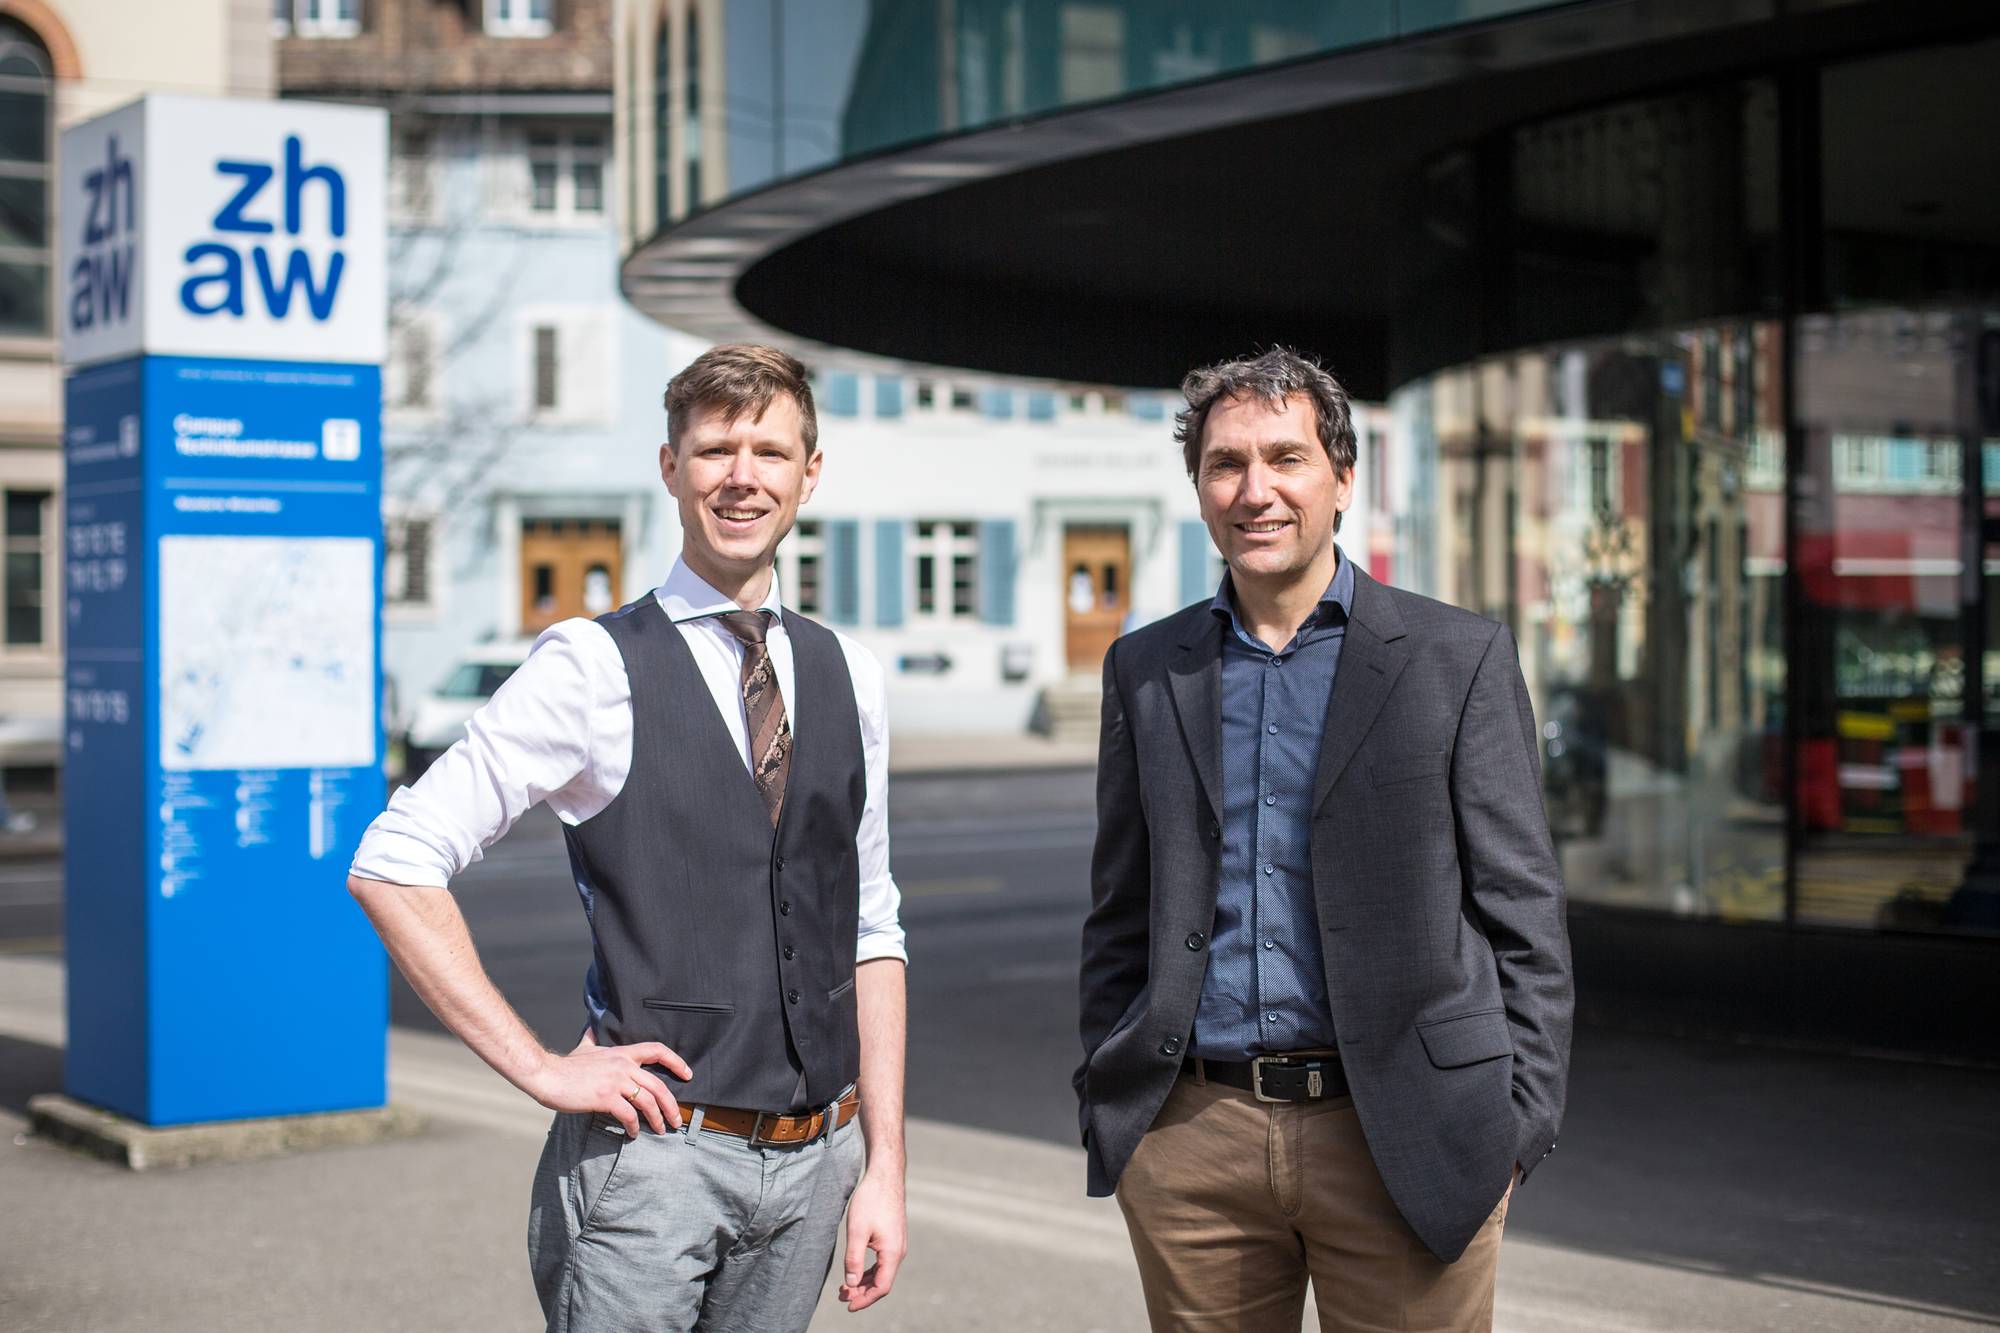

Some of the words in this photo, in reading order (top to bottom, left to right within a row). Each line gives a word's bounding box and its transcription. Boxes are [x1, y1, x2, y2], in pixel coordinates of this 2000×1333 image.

[84, 134, 134, 245] zh
[213, 135, 346, 238] zh
[70, 245, 134, 334] aw
[179, 243, 346, 321] aw
